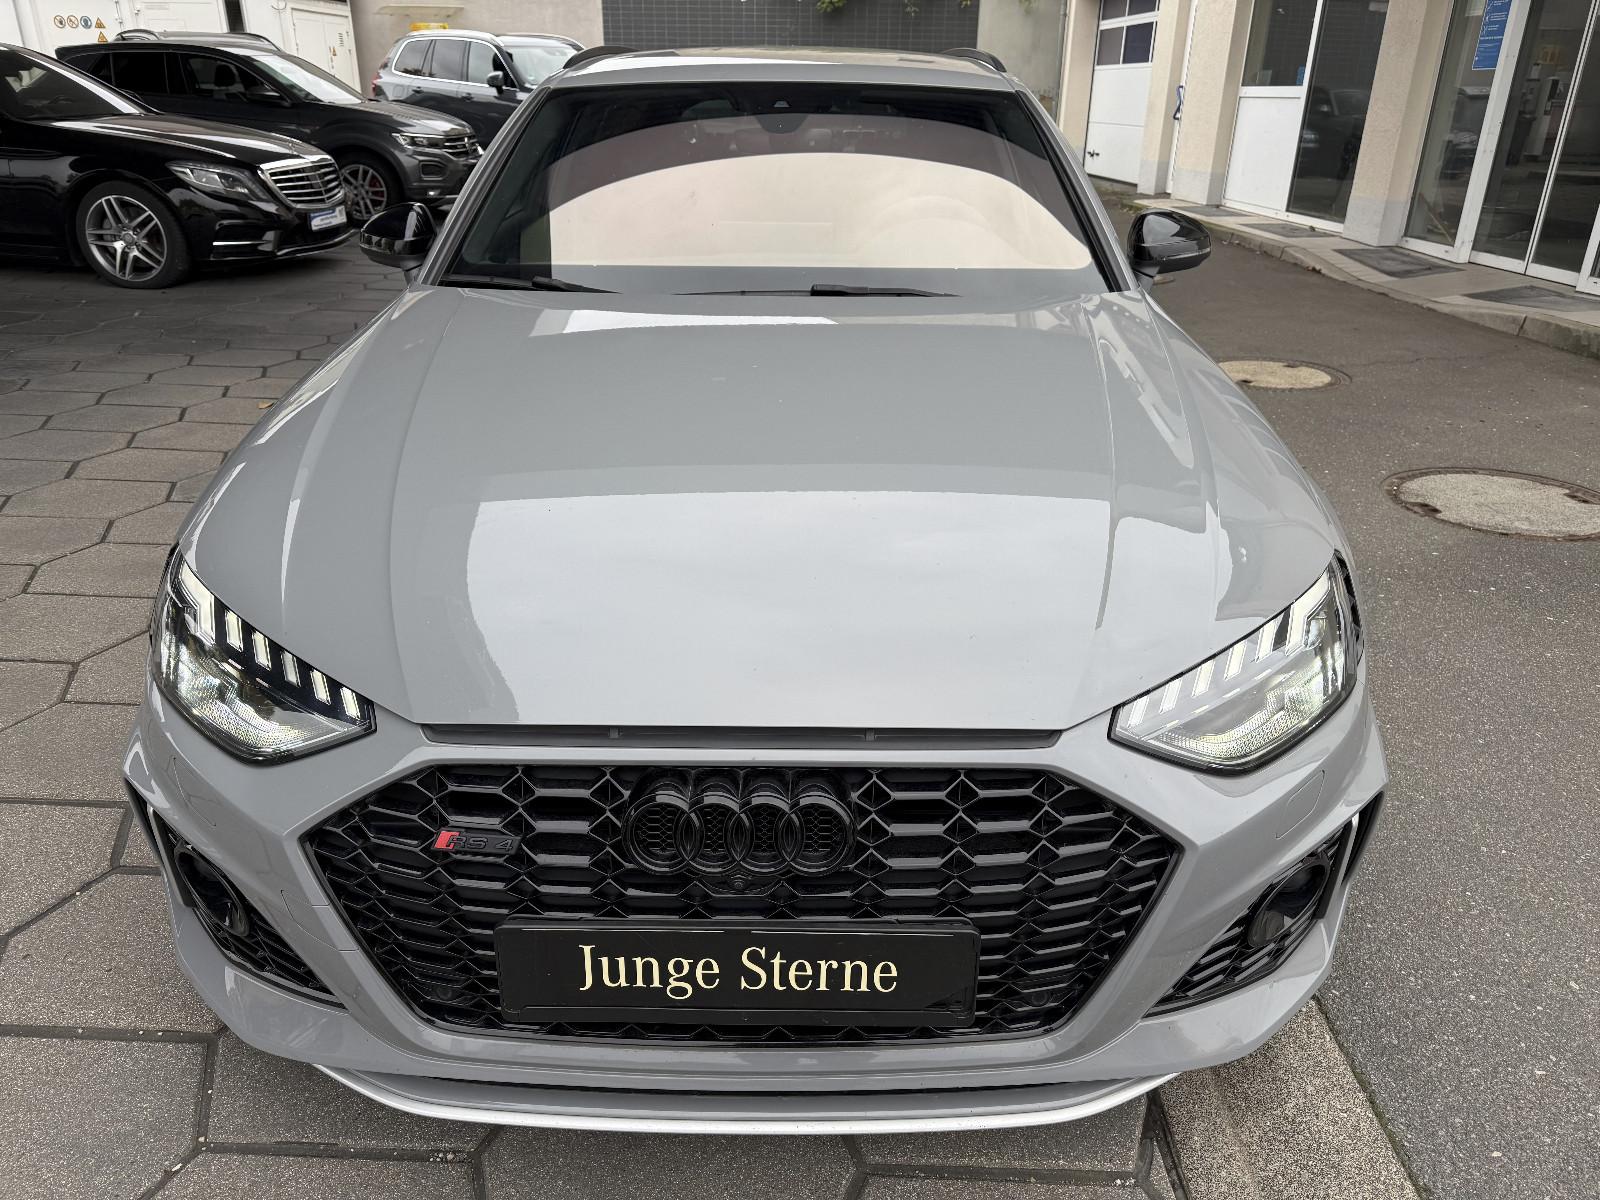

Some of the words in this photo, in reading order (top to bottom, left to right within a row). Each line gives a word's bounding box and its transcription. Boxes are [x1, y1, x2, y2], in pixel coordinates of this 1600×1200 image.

[446, 834, 489, 850] RS
[495, 839, 514, 851] 4
[578, 944, 721, 1000] Junge
[740, 946, 899, 993] Sterne
